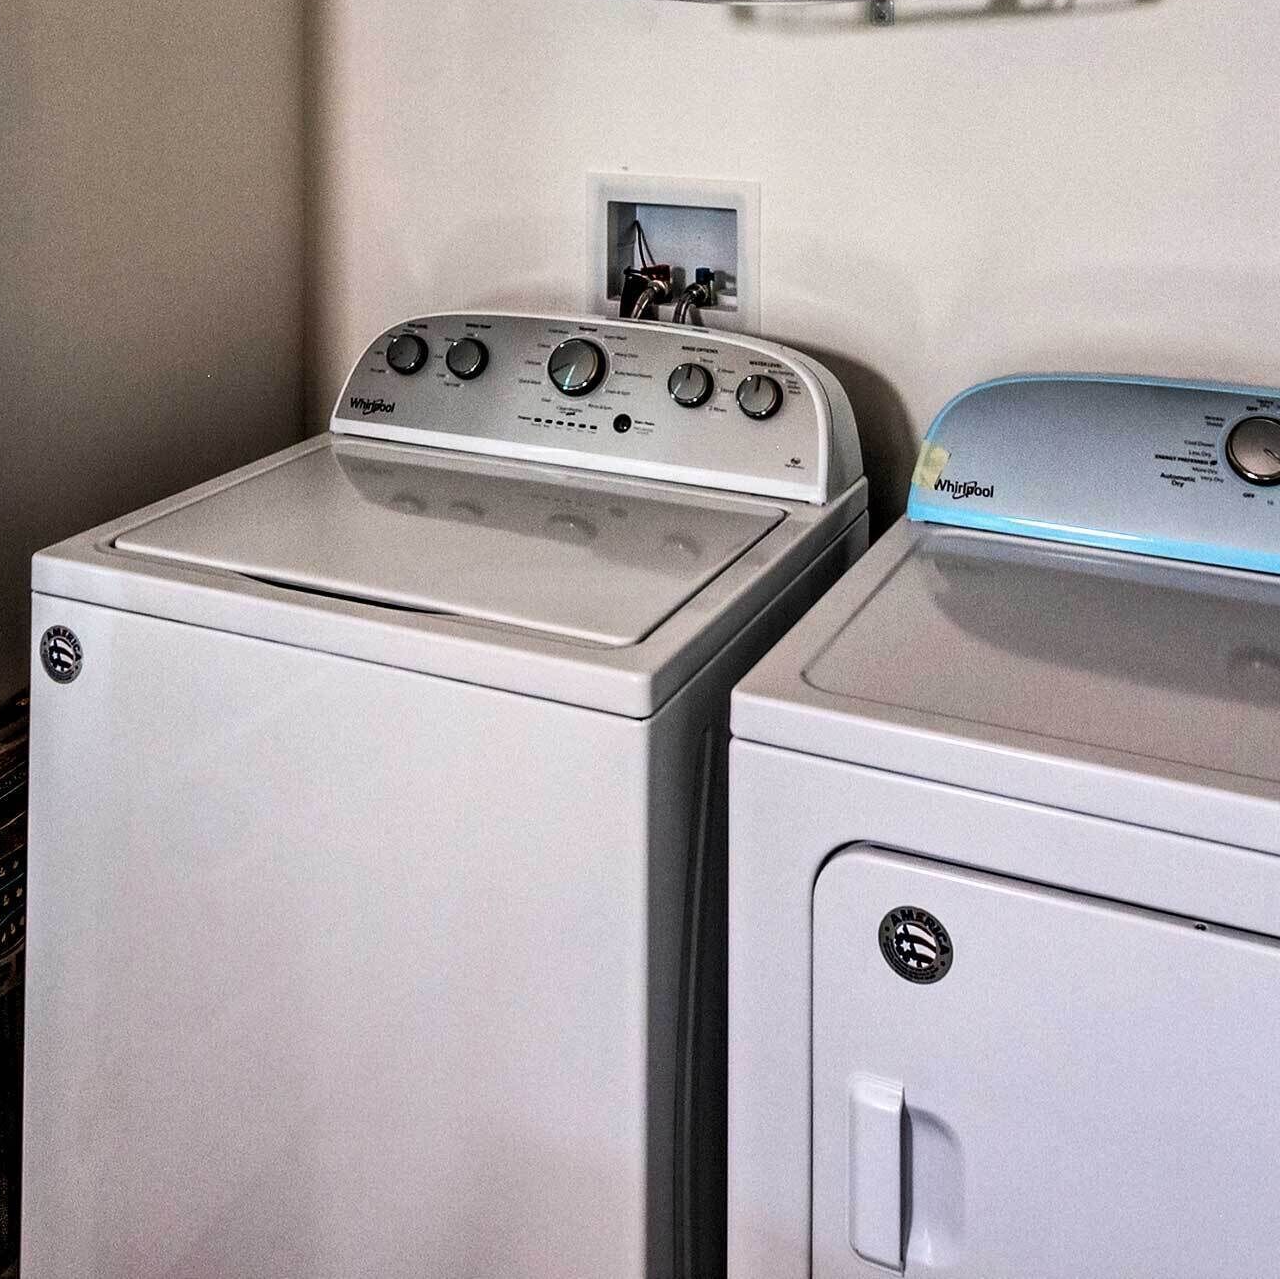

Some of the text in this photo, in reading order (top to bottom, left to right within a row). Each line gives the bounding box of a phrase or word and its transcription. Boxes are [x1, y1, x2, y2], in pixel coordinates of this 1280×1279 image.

[350, 397, 396, 416] Whirlpool
[1160, 472, 1196, 482] Automatic
[1171, 479, 1185, 488] Dry
[934, 479, 995, 500] Whirlpool
[46, 627, 82, 662] AMERICA
[890, 909, 950, 956] AMERICA
